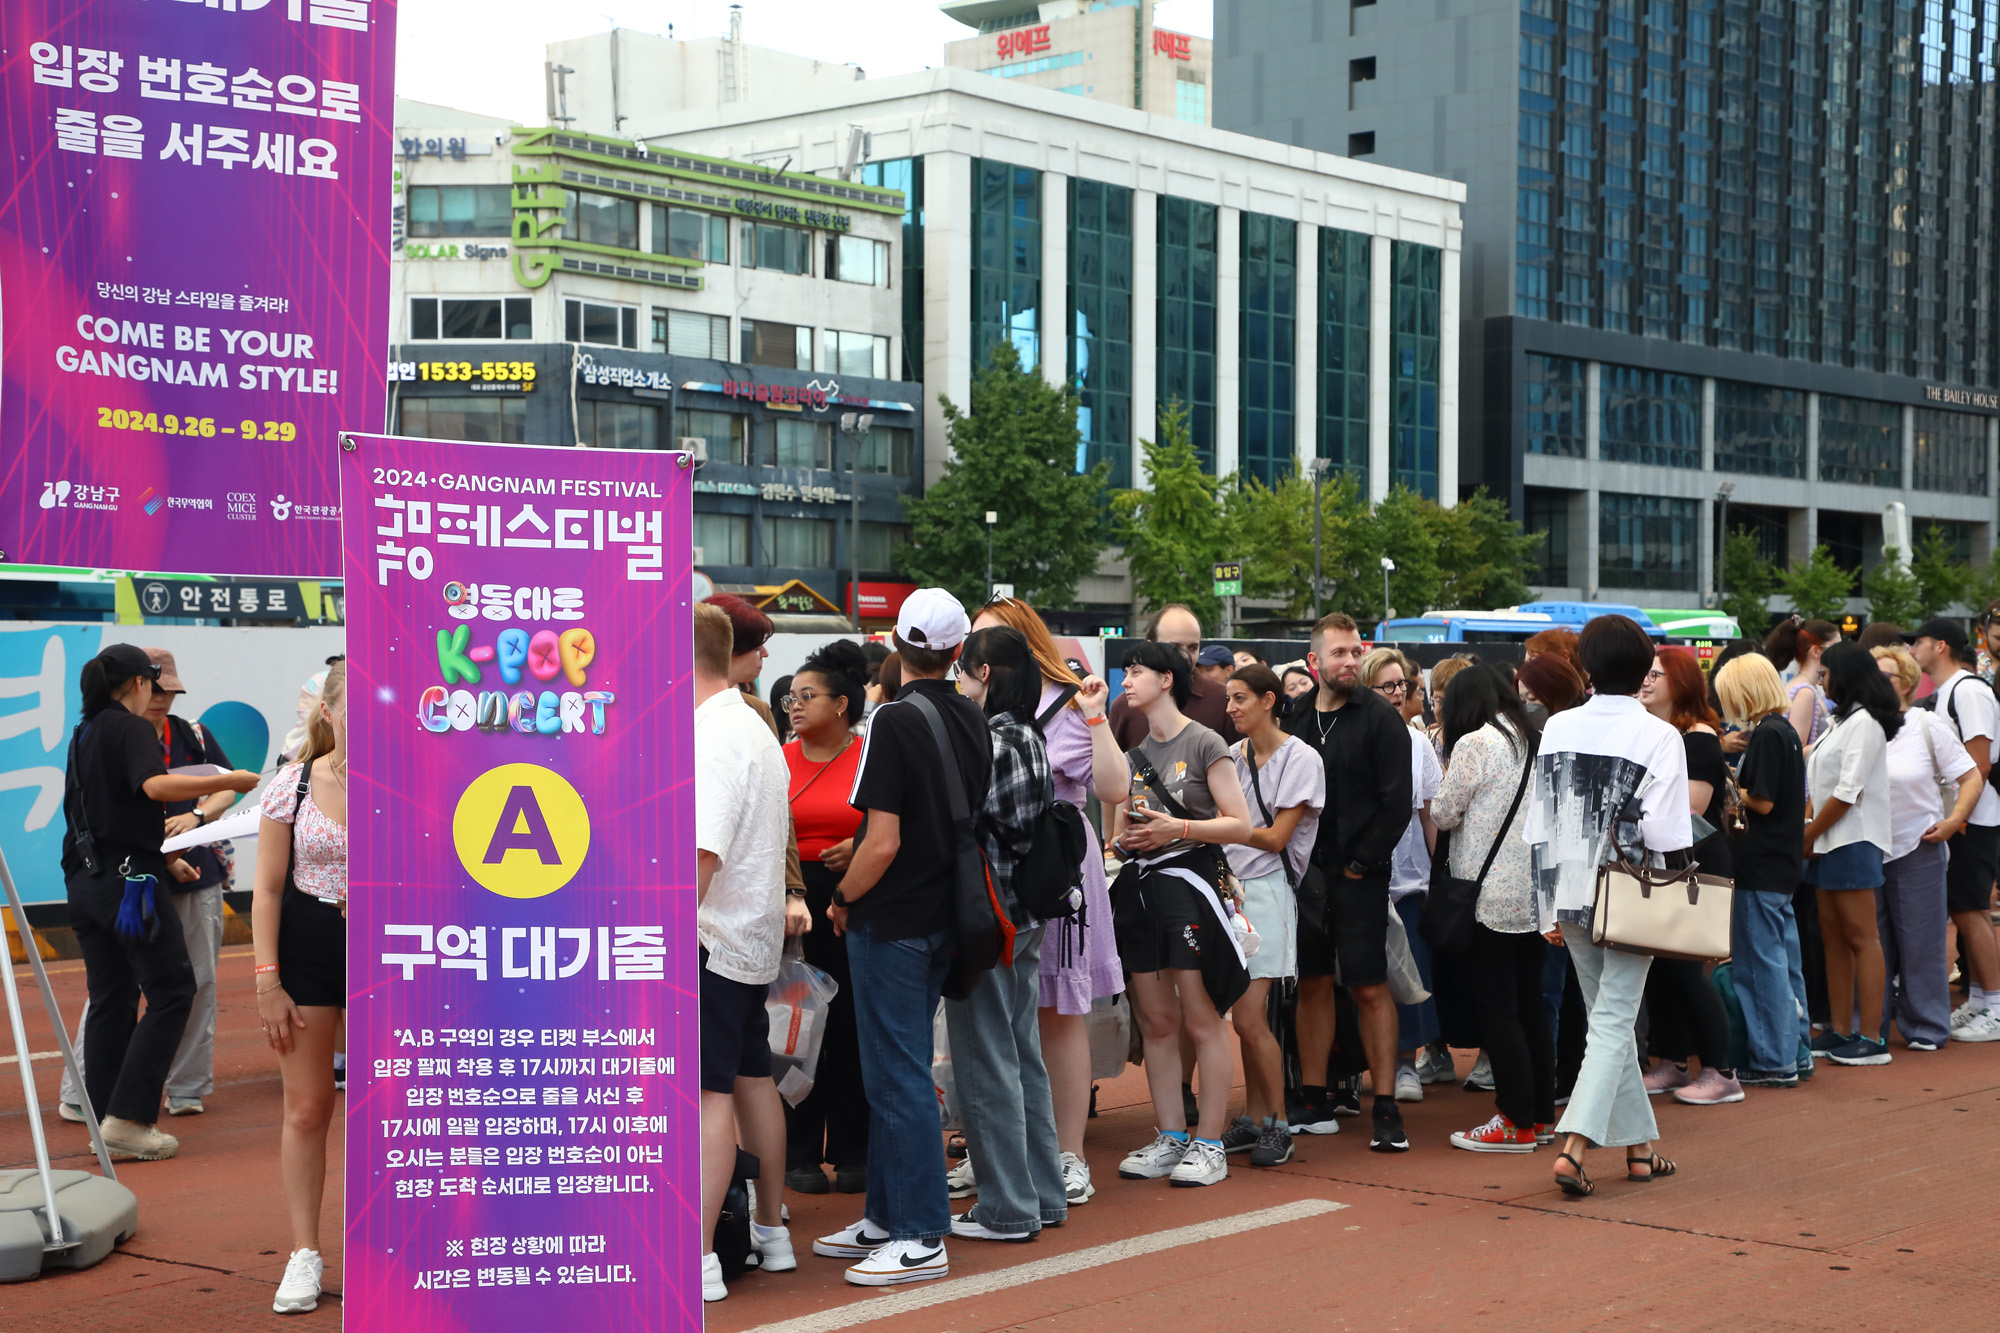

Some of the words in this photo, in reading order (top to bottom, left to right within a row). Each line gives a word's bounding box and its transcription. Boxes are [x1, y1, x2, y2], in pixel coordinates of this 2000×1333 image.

[997, 25, 1050, 60] 위메프
[30, 42, 123, 92] 입장
[139, 56, 361, 123] 번호순으로
[55, 108, 144, 159] 줄을
[160, 123, 338, 179] 서주세요
[401, 137, 467, 162] 한의원
[511, 126, 566, 289] GREEN
[406, 244, 459, 259] SOLAR
[464, 244, 508, 261] Signs
[97, 282, 138, 302] 당신의
[143, 288, 171, 305] 강남
[175, 291, 235, 310] 스타일을
[239, 295, 288, 313] 즐겨라!
[77, 314, 164, 349] COME
[175, 326, 210, 352] BE
[220, 329, 314, 359] YOUR
[56, 346, 228, 388] GANGNAM
[239, 365, 337, 394] STYLE!
[418, 361, 536, 381] 1533-5535
[583, 364, 672, 390] 삼성직업소개소
[722, 379, 827, 407] 바디슬림코리아
[1926, 385, 1942, 401] THE
[1944, 388, 1971, 405] BAILEY
[1973, 393, 1999, 409] HOUSE
[98, 408, 215, 437] 2024.9.26
[241, 420, 295, 441] 9.29
[74, 484, 120, 503] 강남구
[226, 492, 256, 503] COEX
[562, 480, 662, 497] FESTIVAL
[167, 496, 213, 510] 한국무역협회
[227, 502, 256, 514] MICE
[227, 513, 257, 521] CLUSTER
[1215, 566, 1240, 579] 출입구
[180, 586, 288, 613] 안전통로
[1219, 581, 1238, 594] 3-2
[443, 581, 584, 621] 영동대로
[436, 624, 595, 687] K-POP
[419, 686, 615, 735] CONCERT
[482, 785, 562, 865] A
[382, 925, 487, 980] 구역
[502, 926, 666, 980] 대기줄
[440, 1029, 493, 1047] 구역의
[500, 1029, 534, 1047] 경우
[541, 1029, 576, 1046] 티켓
[582, 1028, 654, 1046] 부스에서
[374, 1059, 412, 1077] 입장
[418, 1058, 451, 1077] 팔찌
[457, 1058, 493, 1076] 착용
[499, 1058, 515, 1076] 후
[521, 1058, 595, 1075] 17시까지
[602, 1057, 674, 1075] 대기줄에
[406, 1088, 443, 1106] 입장
[448, 1088, 536, 1105] 번호순으로
[542, 1087, 578, 1105] 줄을
[585, 1087, 619, 1104] 서신
[626, 1087, 643, 1104] 후
[382, 1118, 440, 1137] 17시에
[447, 1118, 479, 1135] 일괄
[485, 1117, 562, 1135] 입장하며,
[568, 1117, 606, 1134] 17시
[613, 1116, 667, 1134] 이후에
[386, 1148, 443, 1167] 오시는
[450, 1147, 500, 1165] 분들은
[506, 1147, 542, 1165] 입장
[548, 1146, 620, 1164] 번호순이
[627, 1145, 662, 1163] 아닌
[396, 1179, 434, 1198] 현장
[440, 1177, 477, 1195] 도착
[482, 1177, 551, 1195] 순서대로
[557, 1175, 654, 1193] 입장합니다.
[471, 1237, 507, 1256] 현장
[512, 1236, 563, 1255] 상황에
[570, 1235, 606, 1256] 따라
[414, 1269, 470, 1289] 시간은
[478, 1267, 530, 1286] 변동될
[536, 1267, 551, 1285] 수
[557, 1265, 636, 1284] 있습니다.
